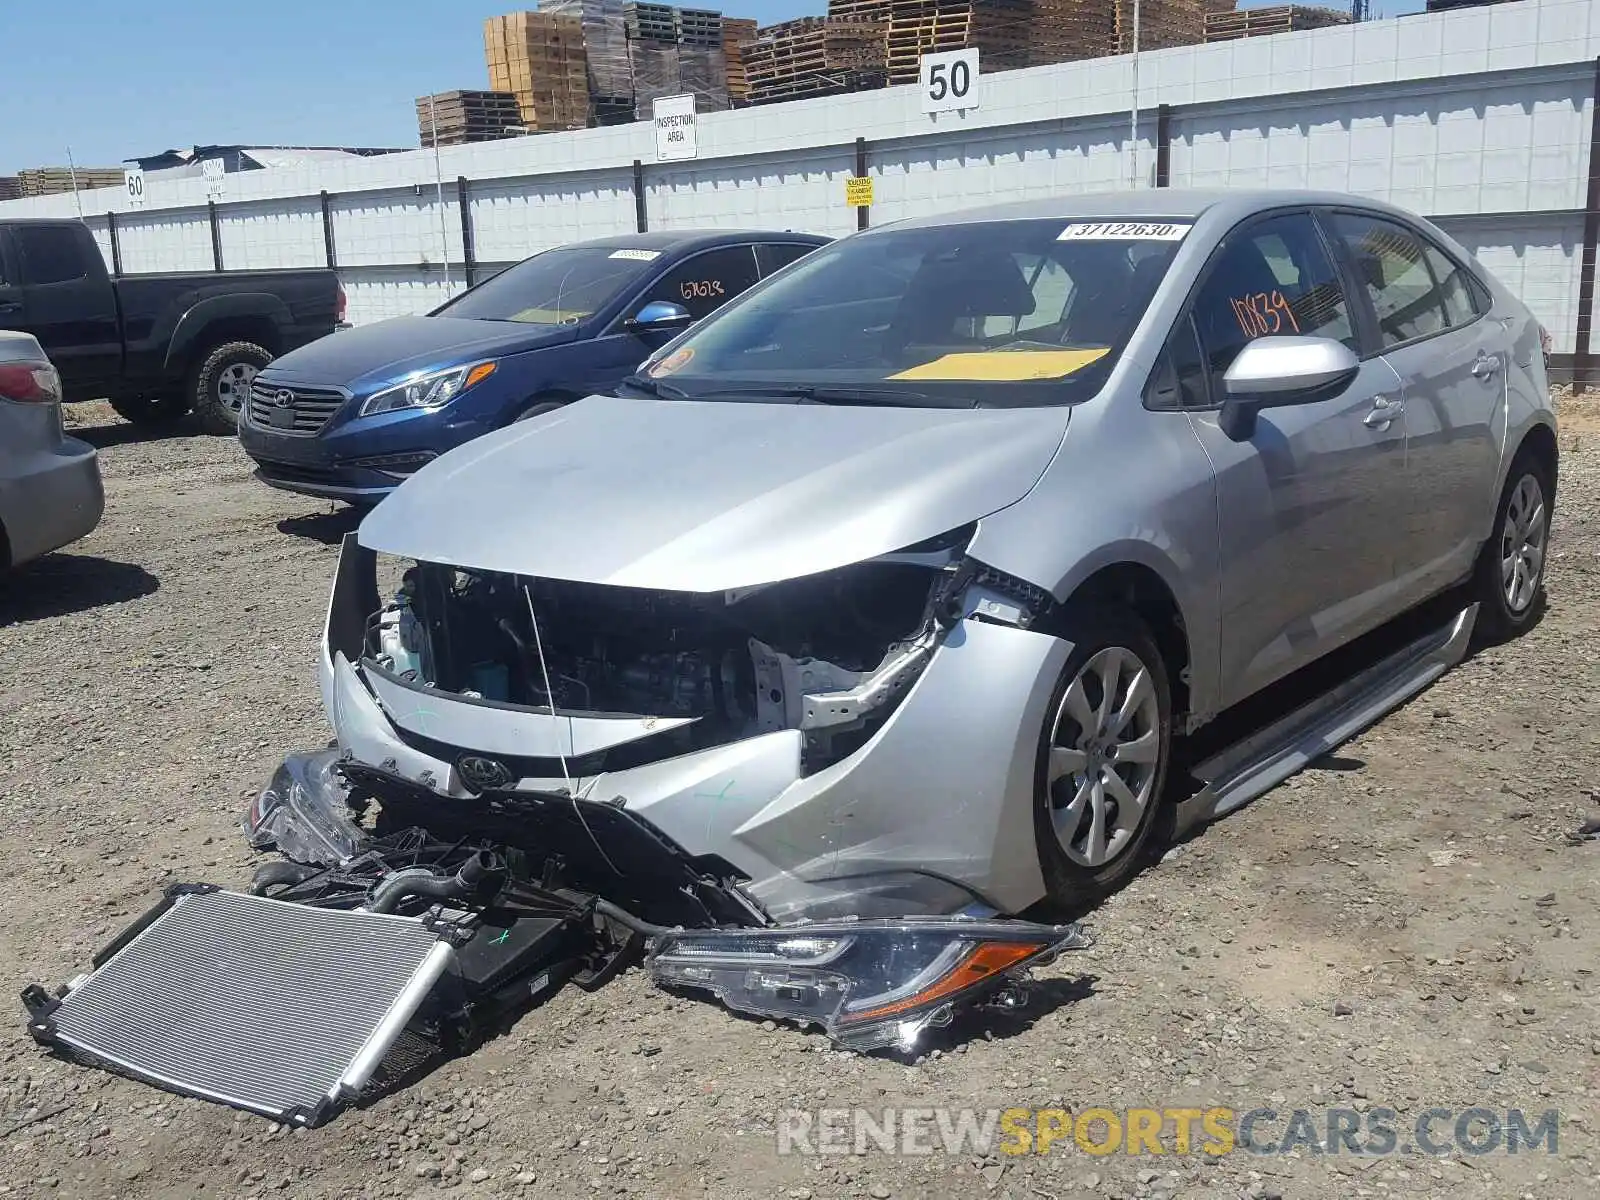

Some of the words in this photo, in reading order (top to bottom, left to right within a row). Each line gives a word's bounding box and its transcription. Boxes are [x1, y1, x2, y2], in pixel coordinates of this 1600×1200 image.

[928, 61, 970, 99] 50
[656, 113, 694, 129] INSPECTION
[667, 130, 685, 143] AREA
[128, 176, 143, 196] 60
[1230, 291, 1299, 338] 10839
